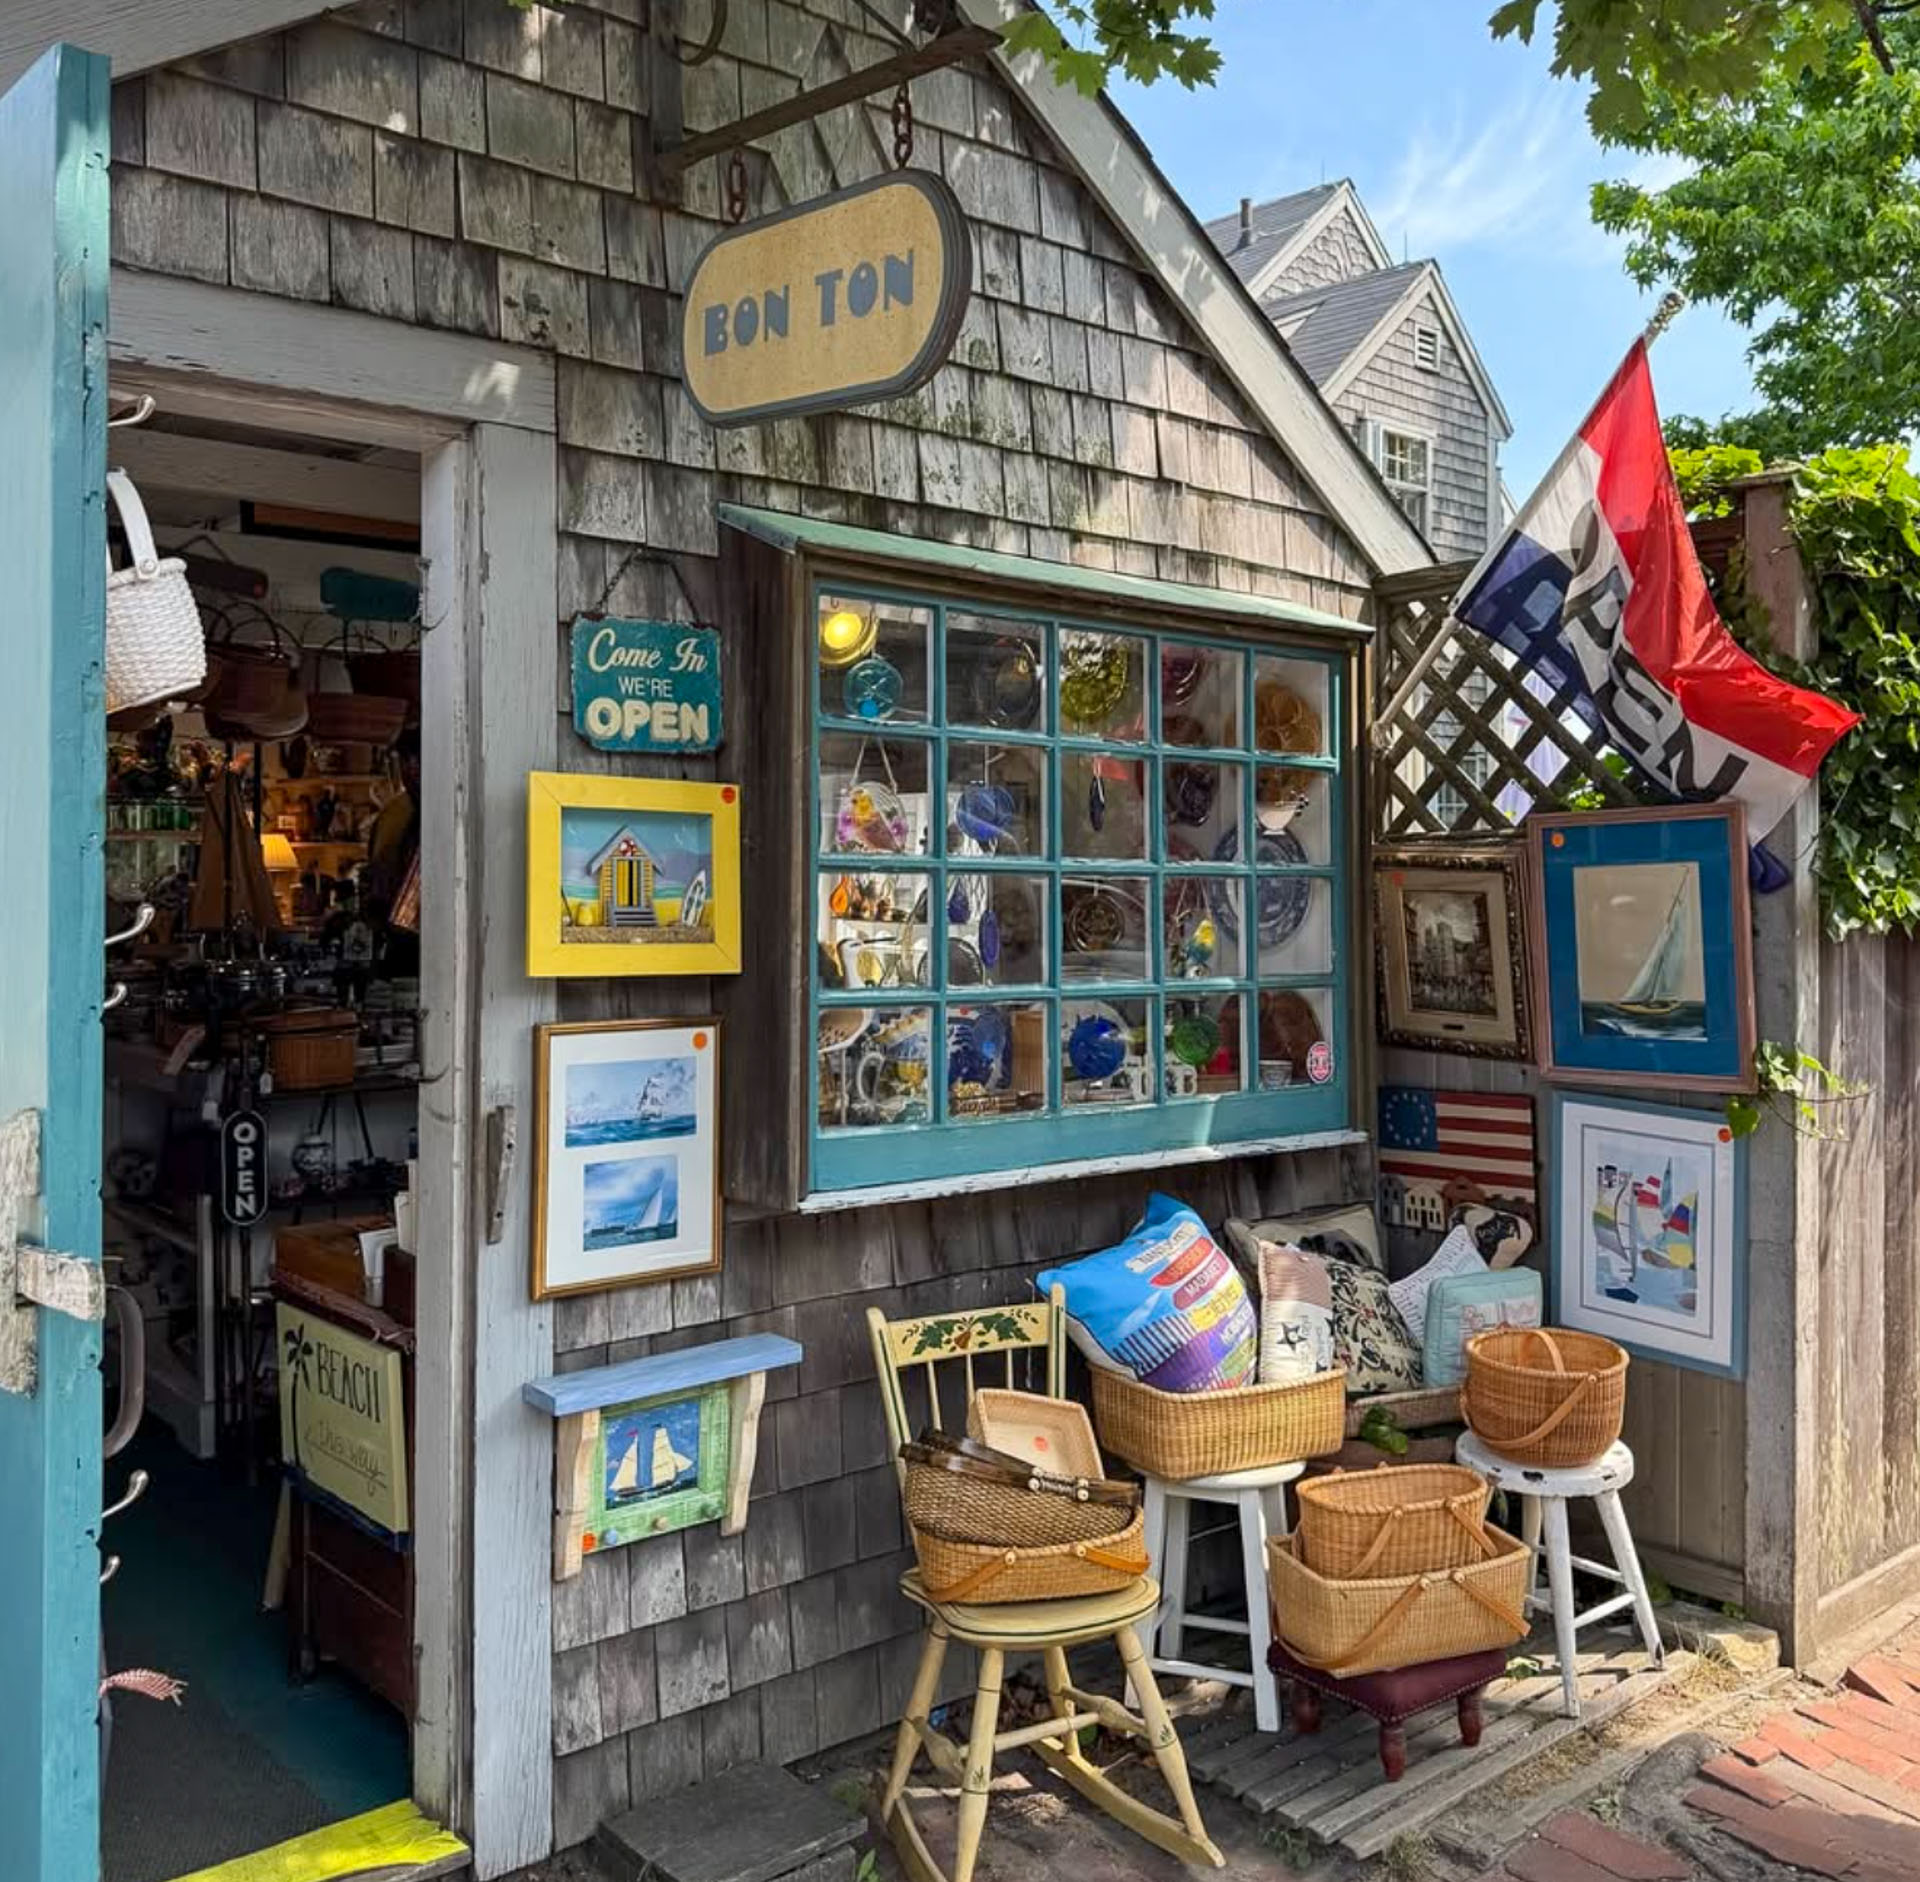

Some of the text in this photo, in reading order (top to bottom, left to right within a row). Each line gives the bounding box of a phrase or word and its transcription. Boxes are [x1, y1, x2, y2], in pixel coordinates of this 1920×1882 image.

[704, 248, 915, 357] BON TON
[588, 627, 708, 673] Come In
[617, 675, 673, 698] WE'RE
[586, 697, 710, 745] OPEN
[232, 1122, 258, 1218] OPEN
[315, 1341, 381, 1424] BEACH
[318, 1419, 386, 1497] this way
